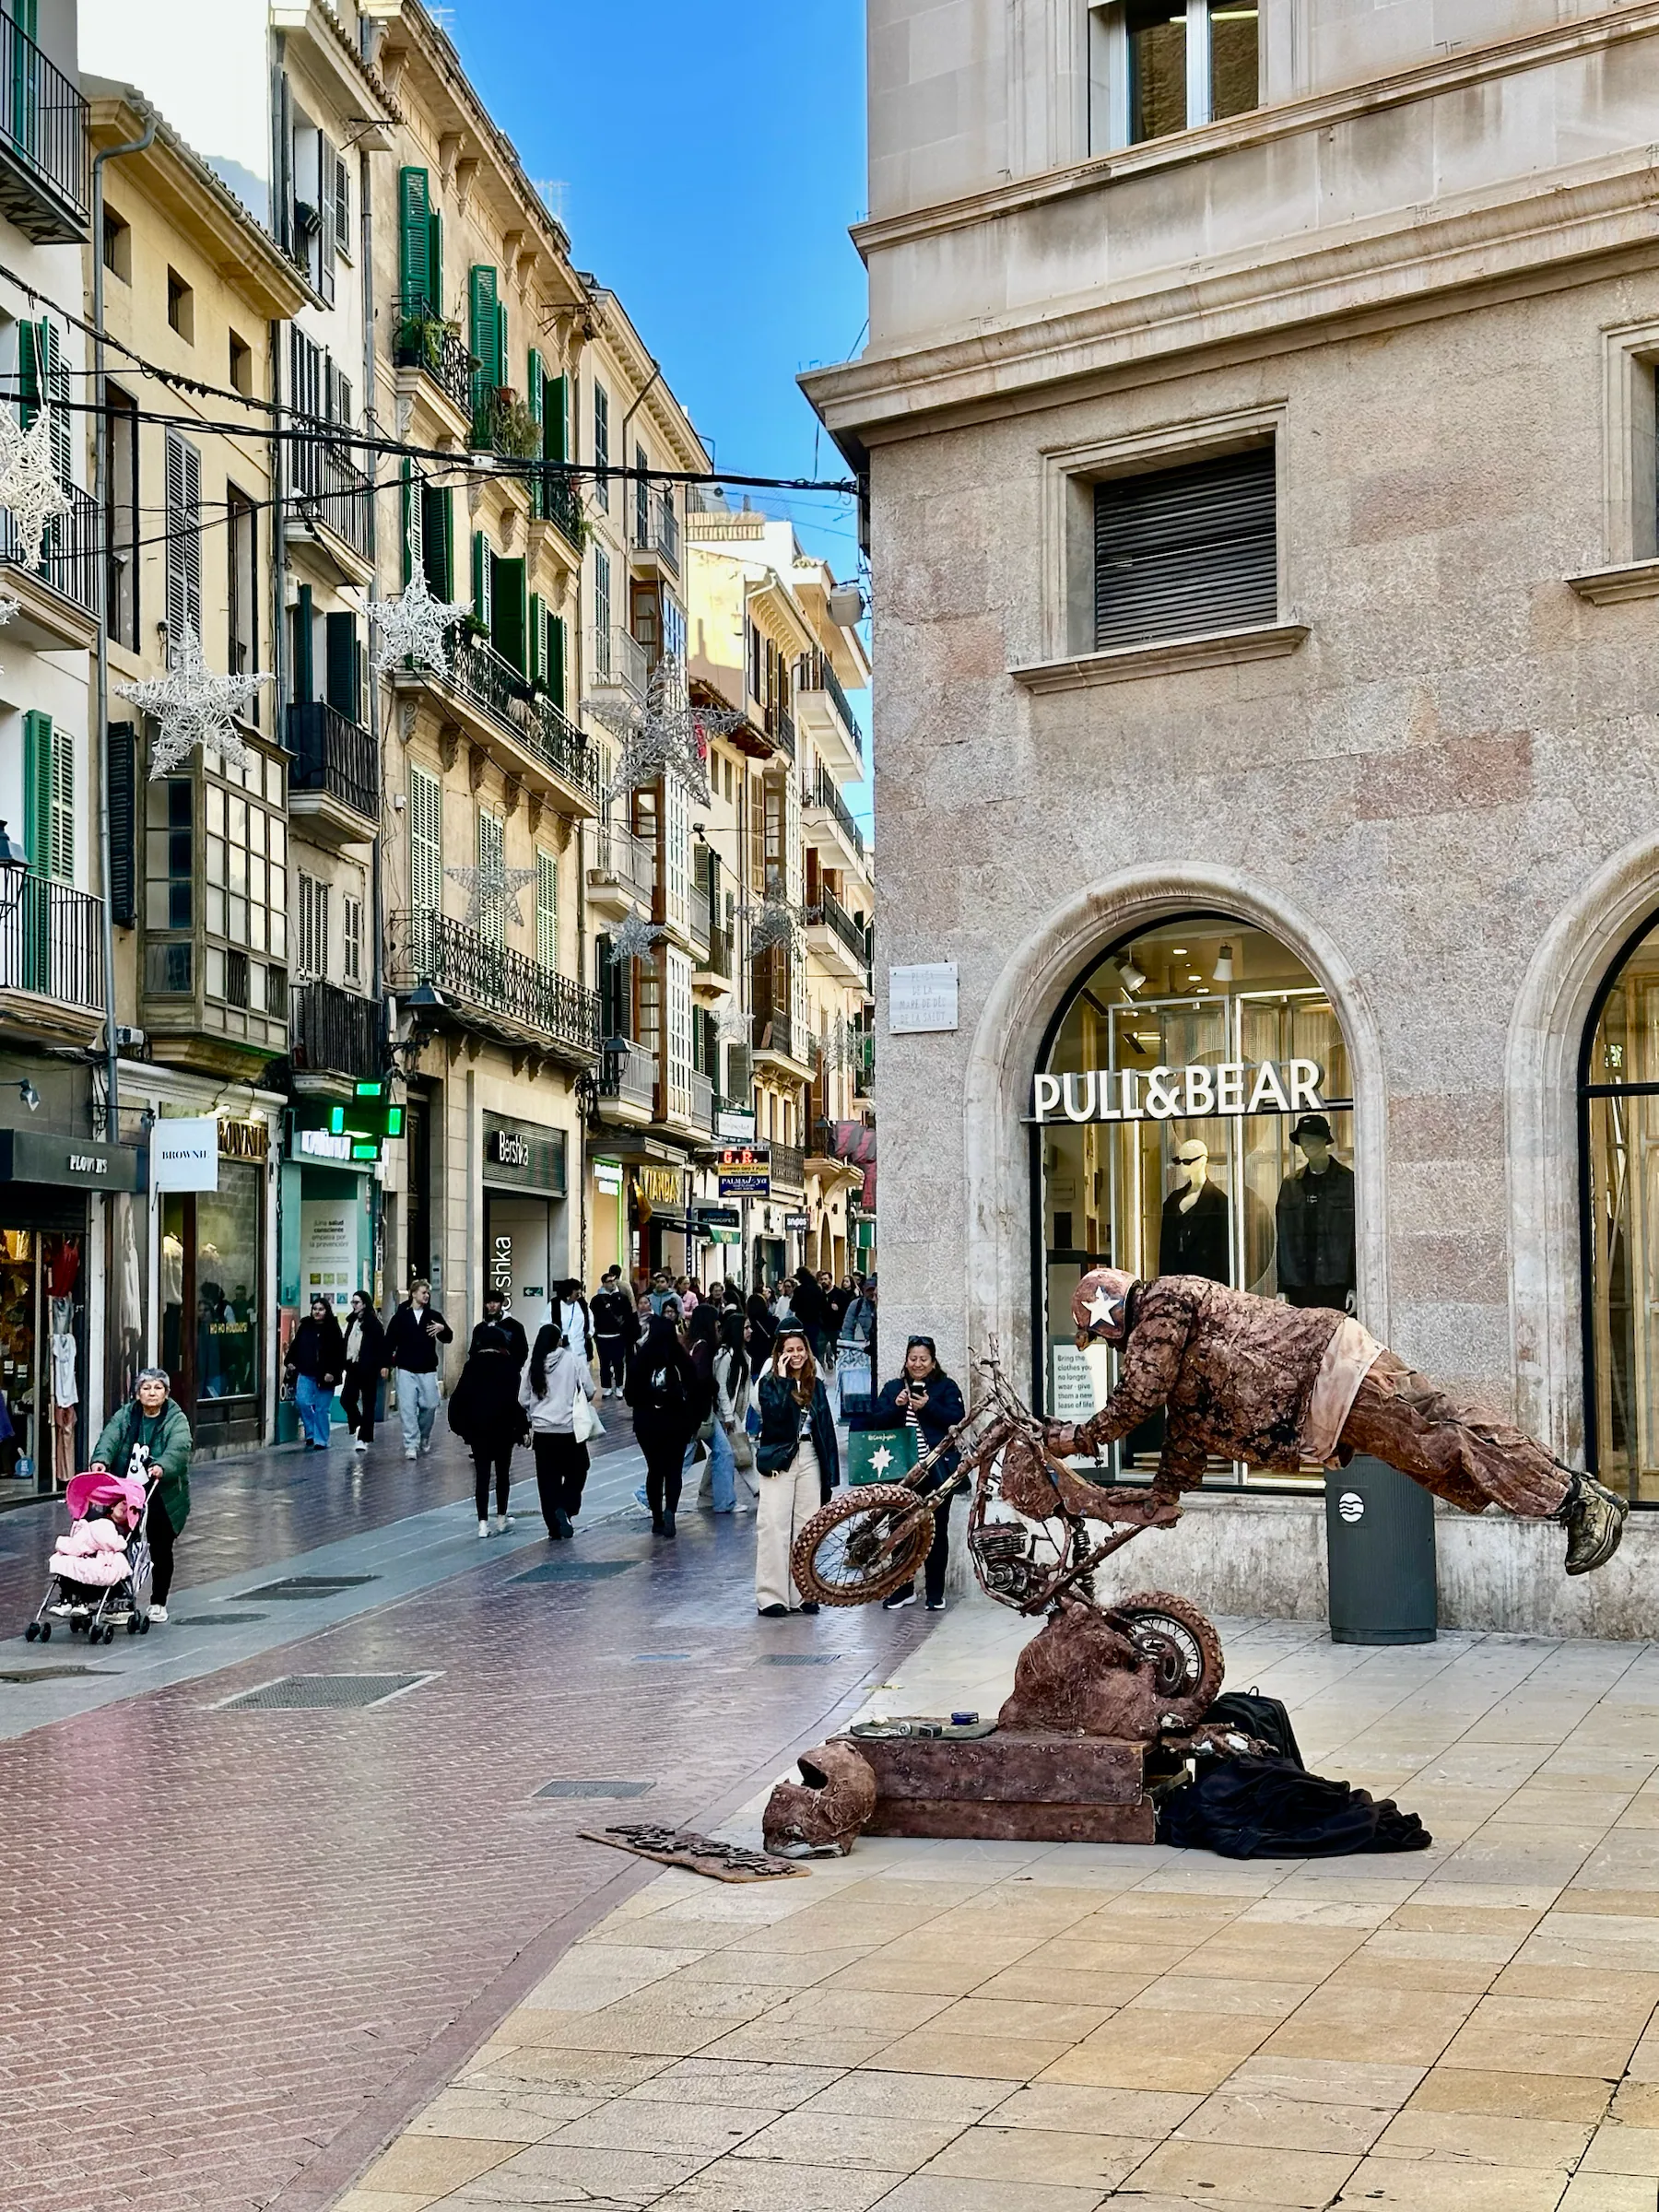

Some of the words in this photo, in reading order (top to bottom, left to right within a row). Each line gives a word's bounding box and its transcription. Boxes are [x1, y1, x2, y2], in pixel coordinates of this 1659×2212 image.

[912, 985, 921, 995] DE
[924, 985, 933, 994] LA
[899, 999, 920, 1010] MARE
[922, 998, 931, 1008] DE
[900, 1014, 909, 1024] DE
[912, 1013, 921, 1023] LA
[924, 1011, 946, 1022] SALUT
[1033, 1058, 1325, 1124] PULL&BEAR
[499, 1130, 529, 1167] Bershka
[162, 1149, 209, 1160] BROWNIE
[490, 1236, 512, 1310] ershka
[1057, 1354, 1075, 1363] Bring
[1066, 1372, 1087, 1382] longer
[1077, 1382, 1090, 1391] give
